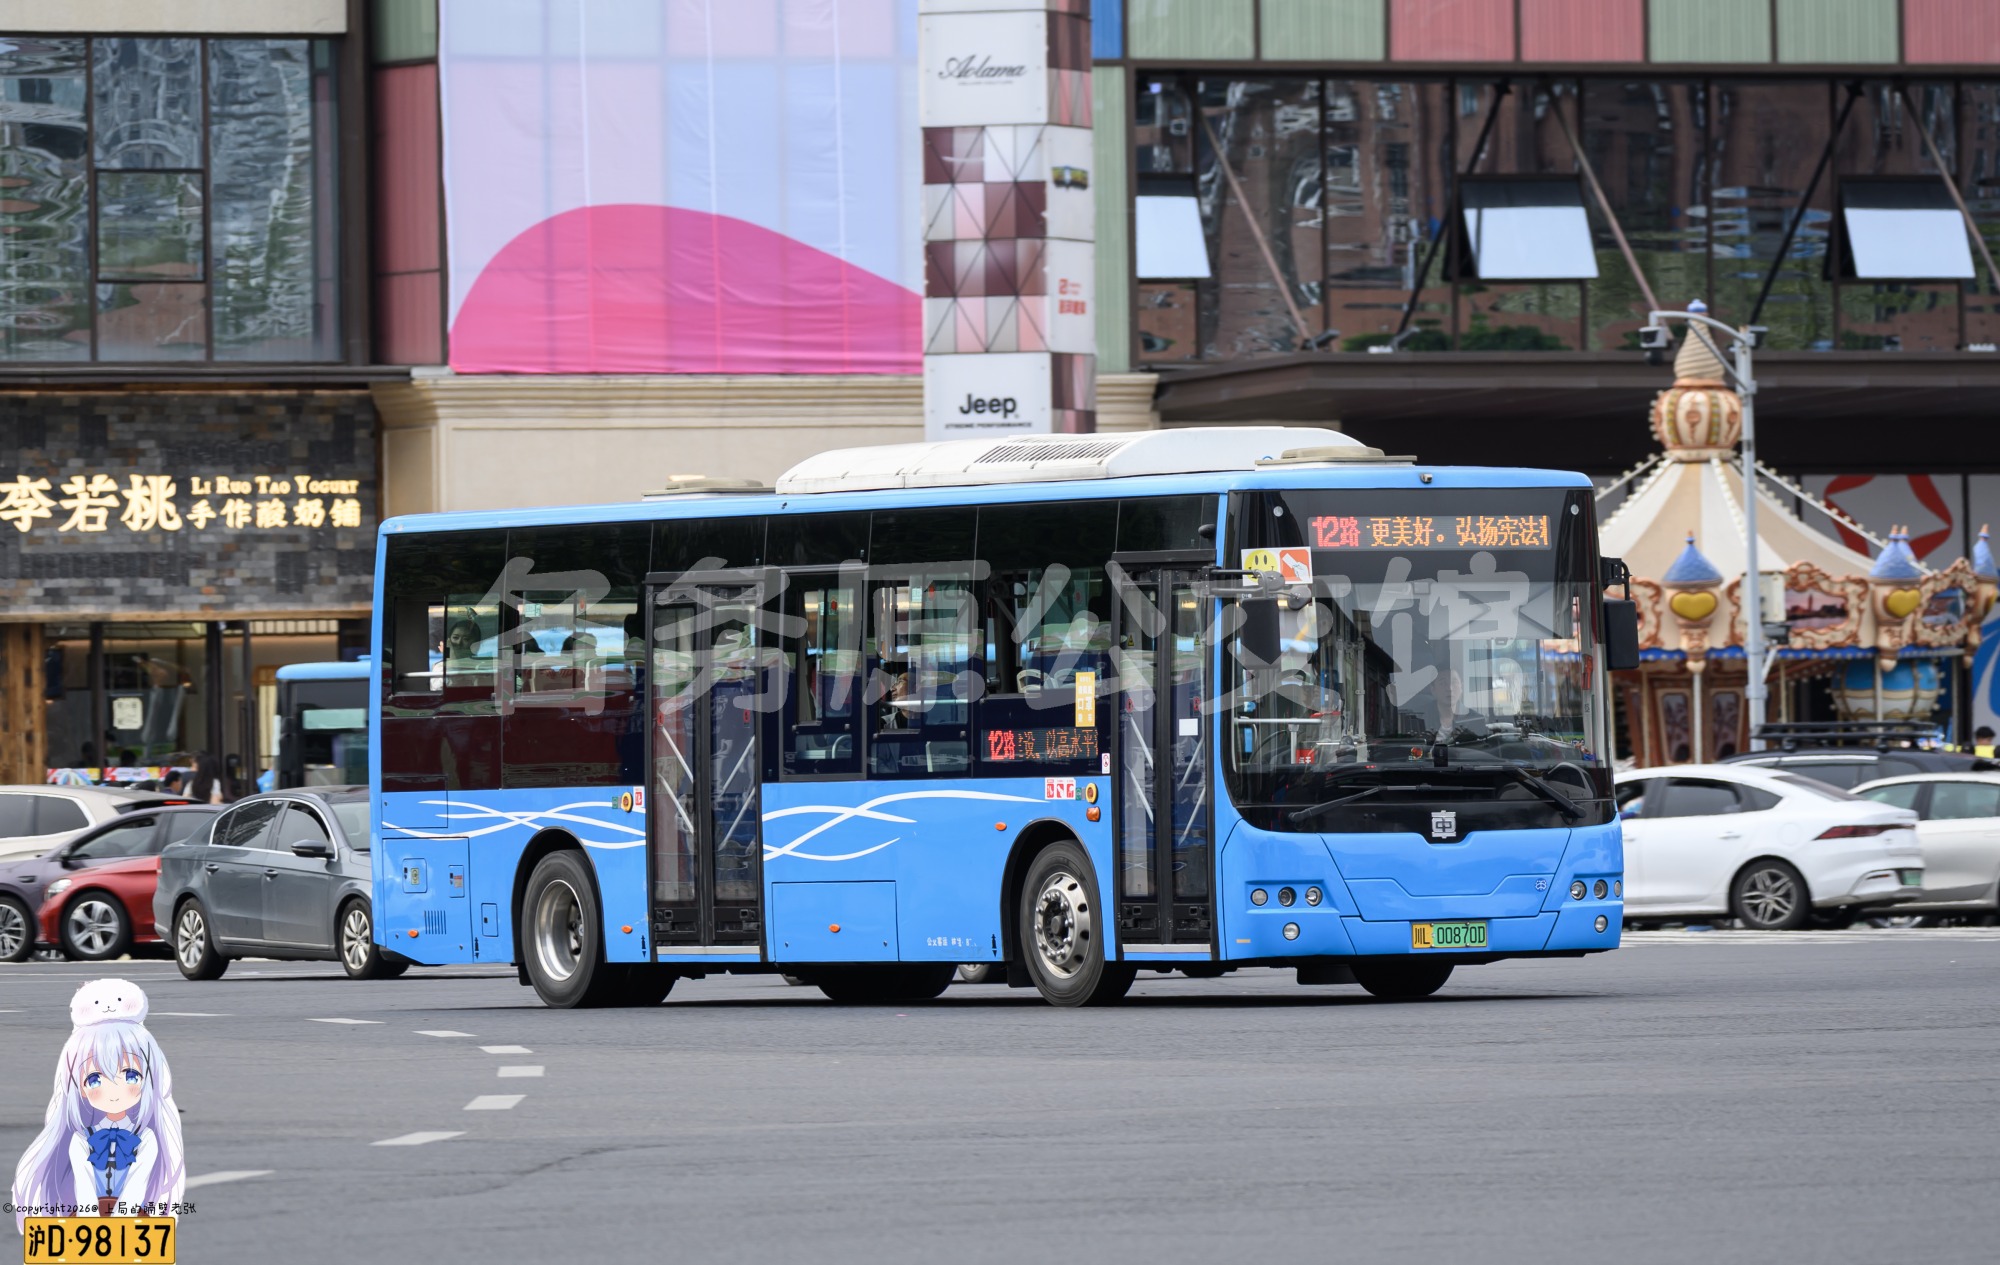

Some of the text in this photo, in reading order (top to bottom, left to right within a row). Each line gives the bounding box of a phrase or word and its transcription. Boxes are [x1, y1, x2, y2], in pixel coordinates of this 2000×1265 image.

[959, 393, 1017, 419] Jeep
[0, 474, 183, 532] 李若桃
[187, 498, 361, 531] 手作酸奶铺
[1312, 516, 1361, 547] 12路
[988, 730, 1015, 760] 12路
